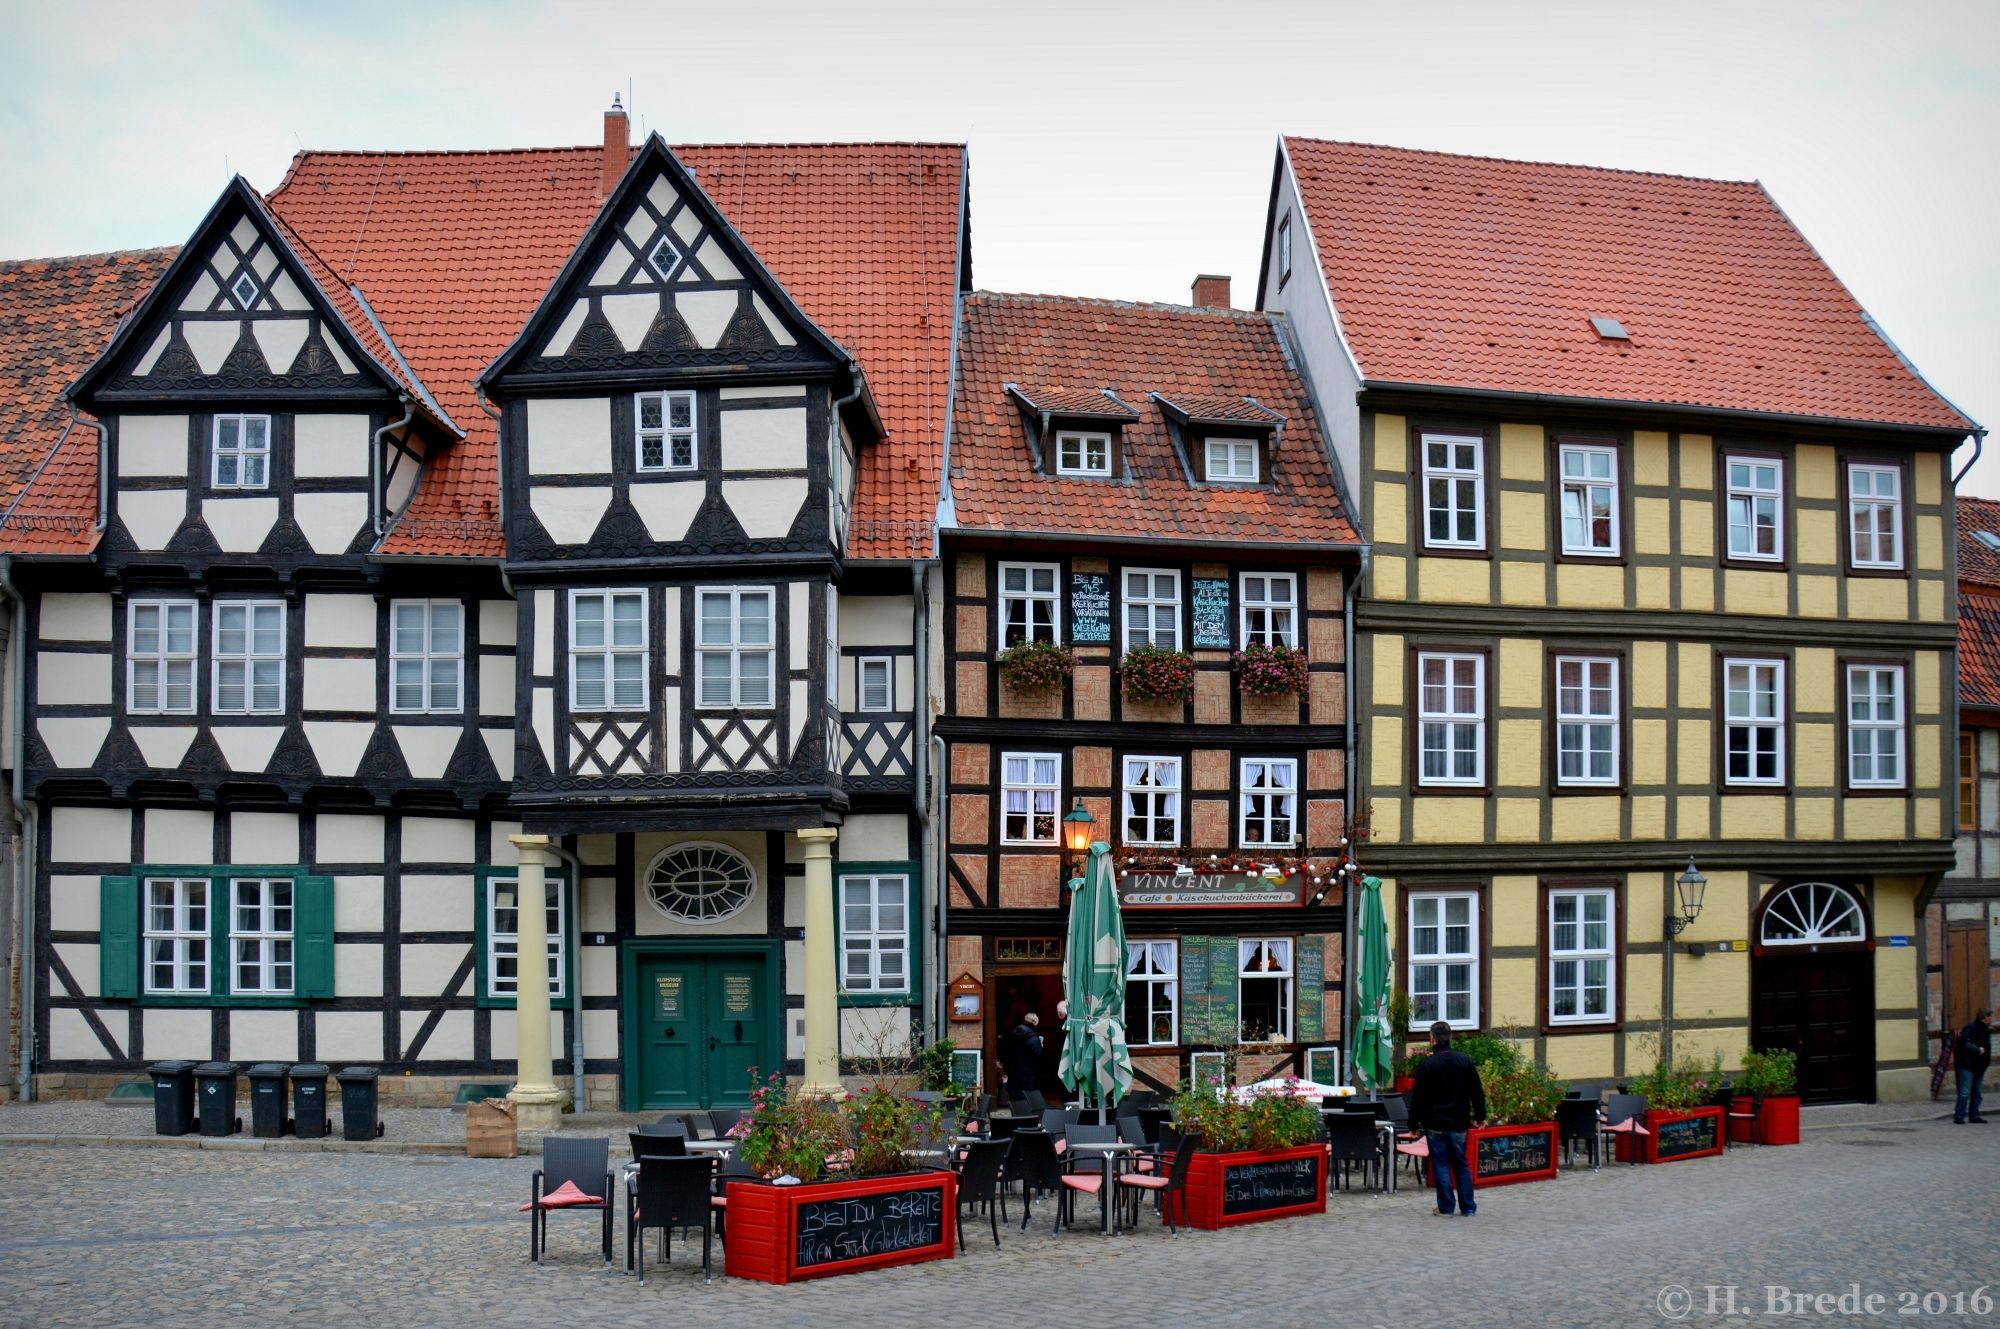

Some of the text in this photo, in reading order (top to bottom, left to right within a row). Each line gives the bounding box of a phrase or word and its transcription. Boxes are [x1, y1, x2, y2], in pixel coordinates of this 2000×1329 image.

[1081, 583, 1100, 593] 145
[1133, 874, 1225, 890] VINCENT
[1138, 893, 1283, 903] Café Käsekuchenbäckerei
[851, 1203, 875, 1223] DU
